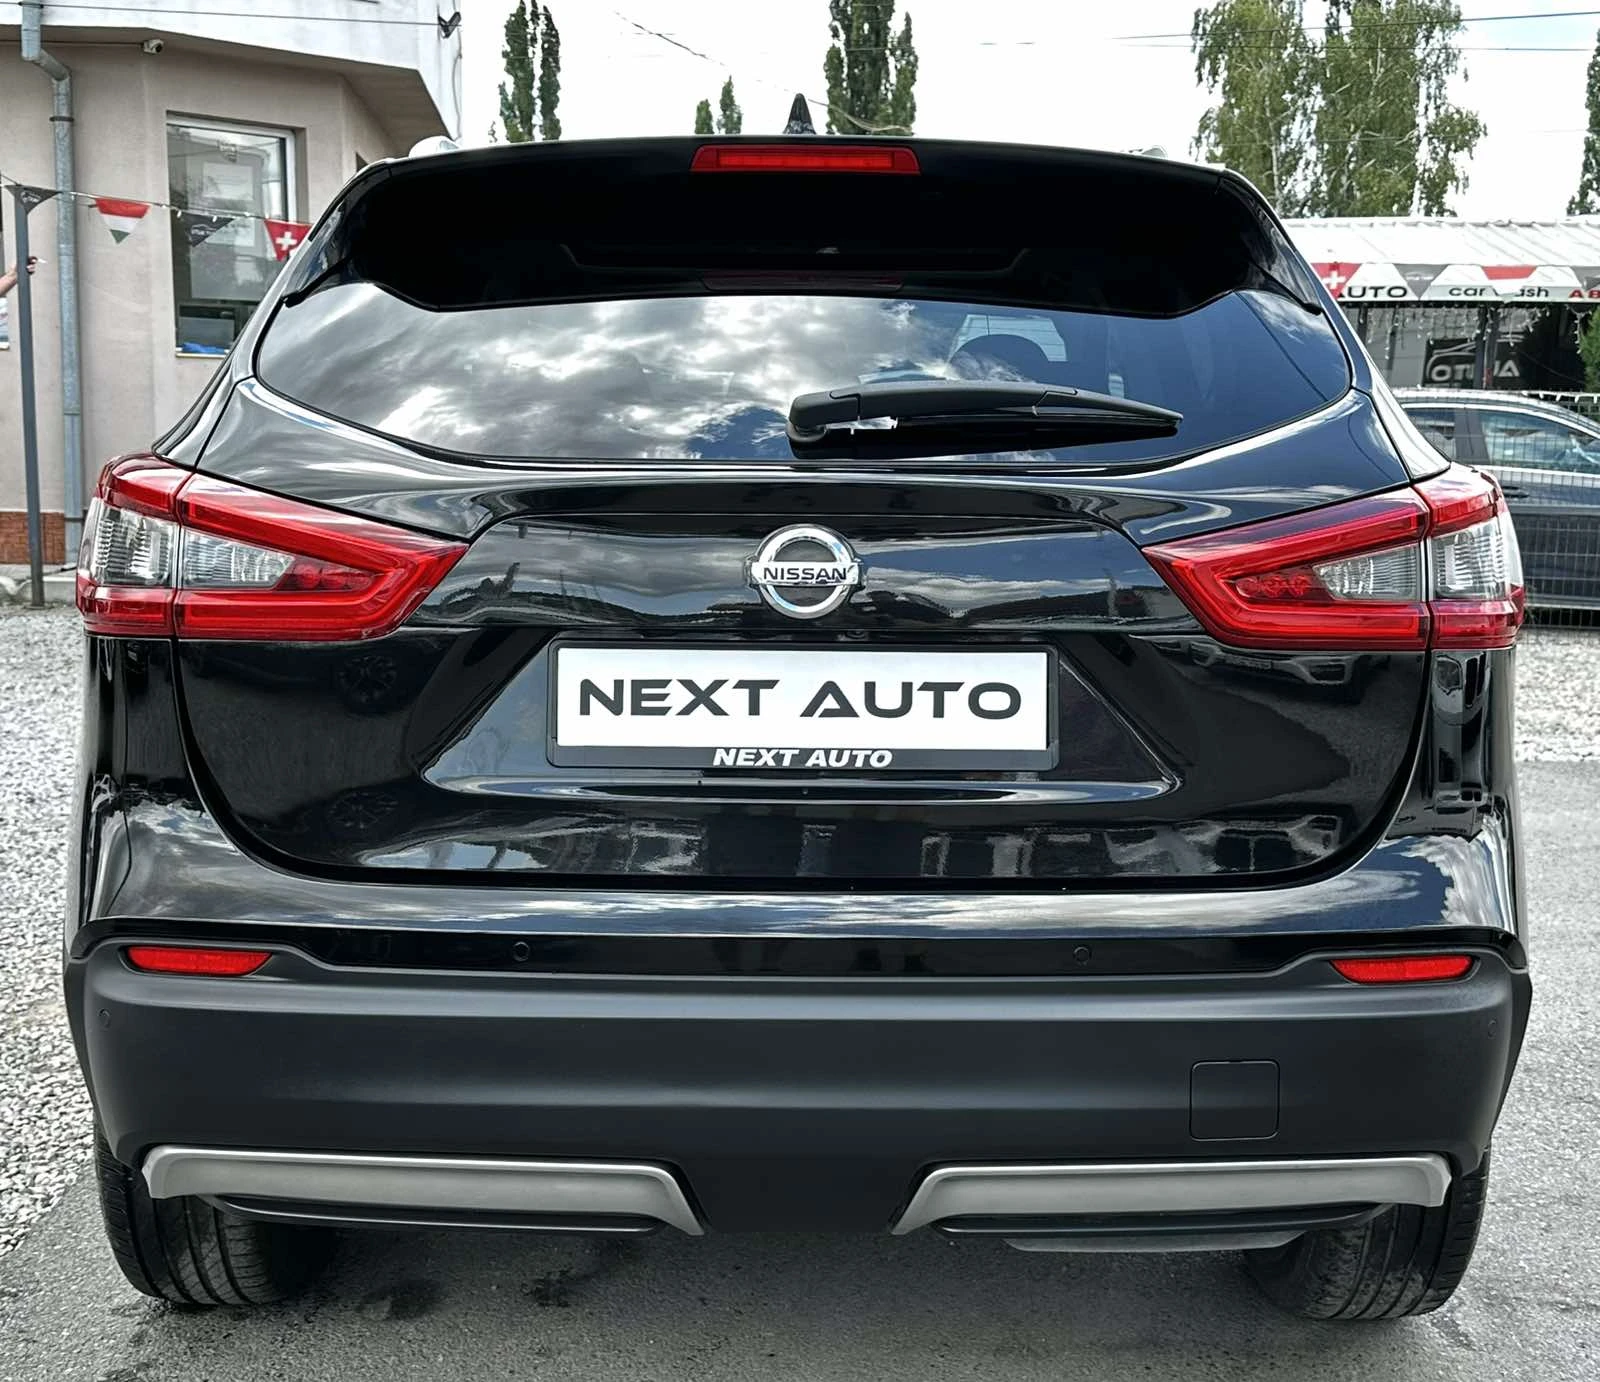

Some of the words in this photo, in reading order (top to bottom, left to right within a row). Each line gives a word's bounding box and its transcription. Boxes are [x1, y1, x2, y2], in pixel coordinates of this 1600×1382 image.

[1338, 286, 1408, 298] UTO
[1449, 286, 1486, 297] car
[1492, 286, 1549, 298] ash
[763, 567, 847, 580] NISSAN
[579, 678, 780, 717] NEXT
[799, 680, 1022, 720] AUTO
[712, 748, 800, 767] NEXT
[804, 749, 893, 769] AUTO
